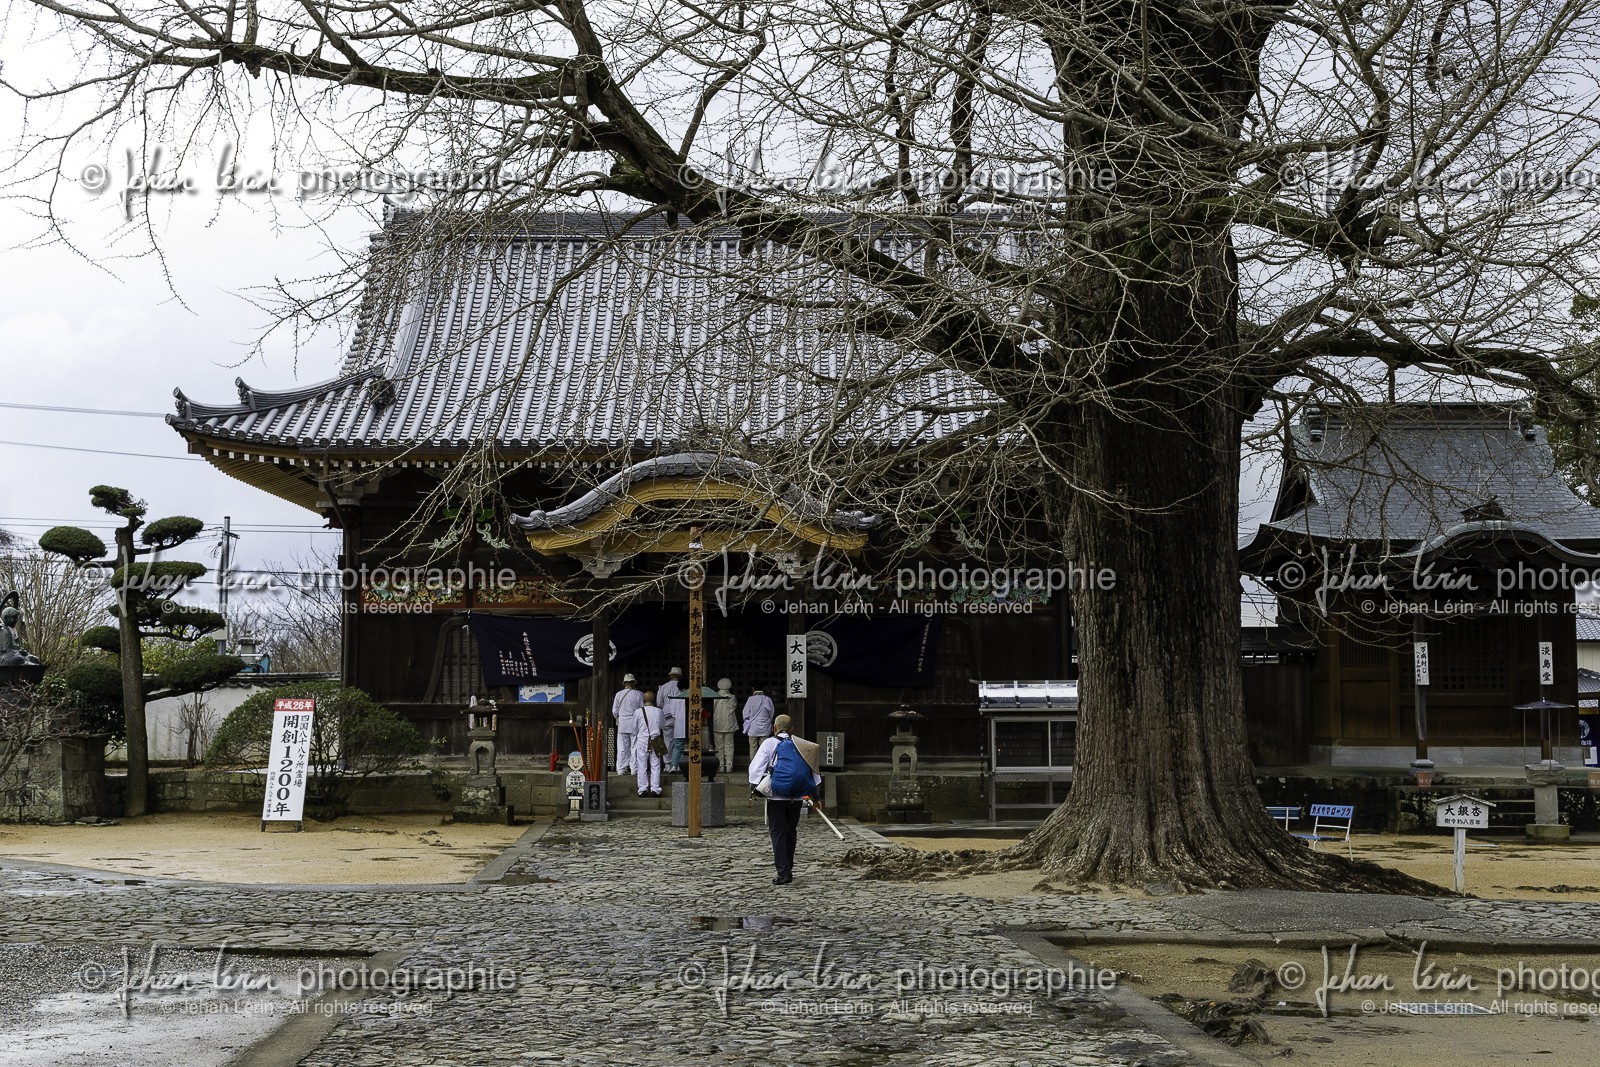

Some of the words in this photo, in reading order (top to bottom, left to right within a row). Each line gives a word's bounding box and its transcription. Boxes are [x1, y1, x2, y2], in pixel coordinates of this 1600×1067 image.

[790, 640, 804, 695] 大師堂
[1541, 646, 1551, 681] 淡島堂
[277, 701, 313, 710] 平成26年
[273, 714, 300, 817] 開創1200年
[1444, 804, 1482, 817] 大銀杏
